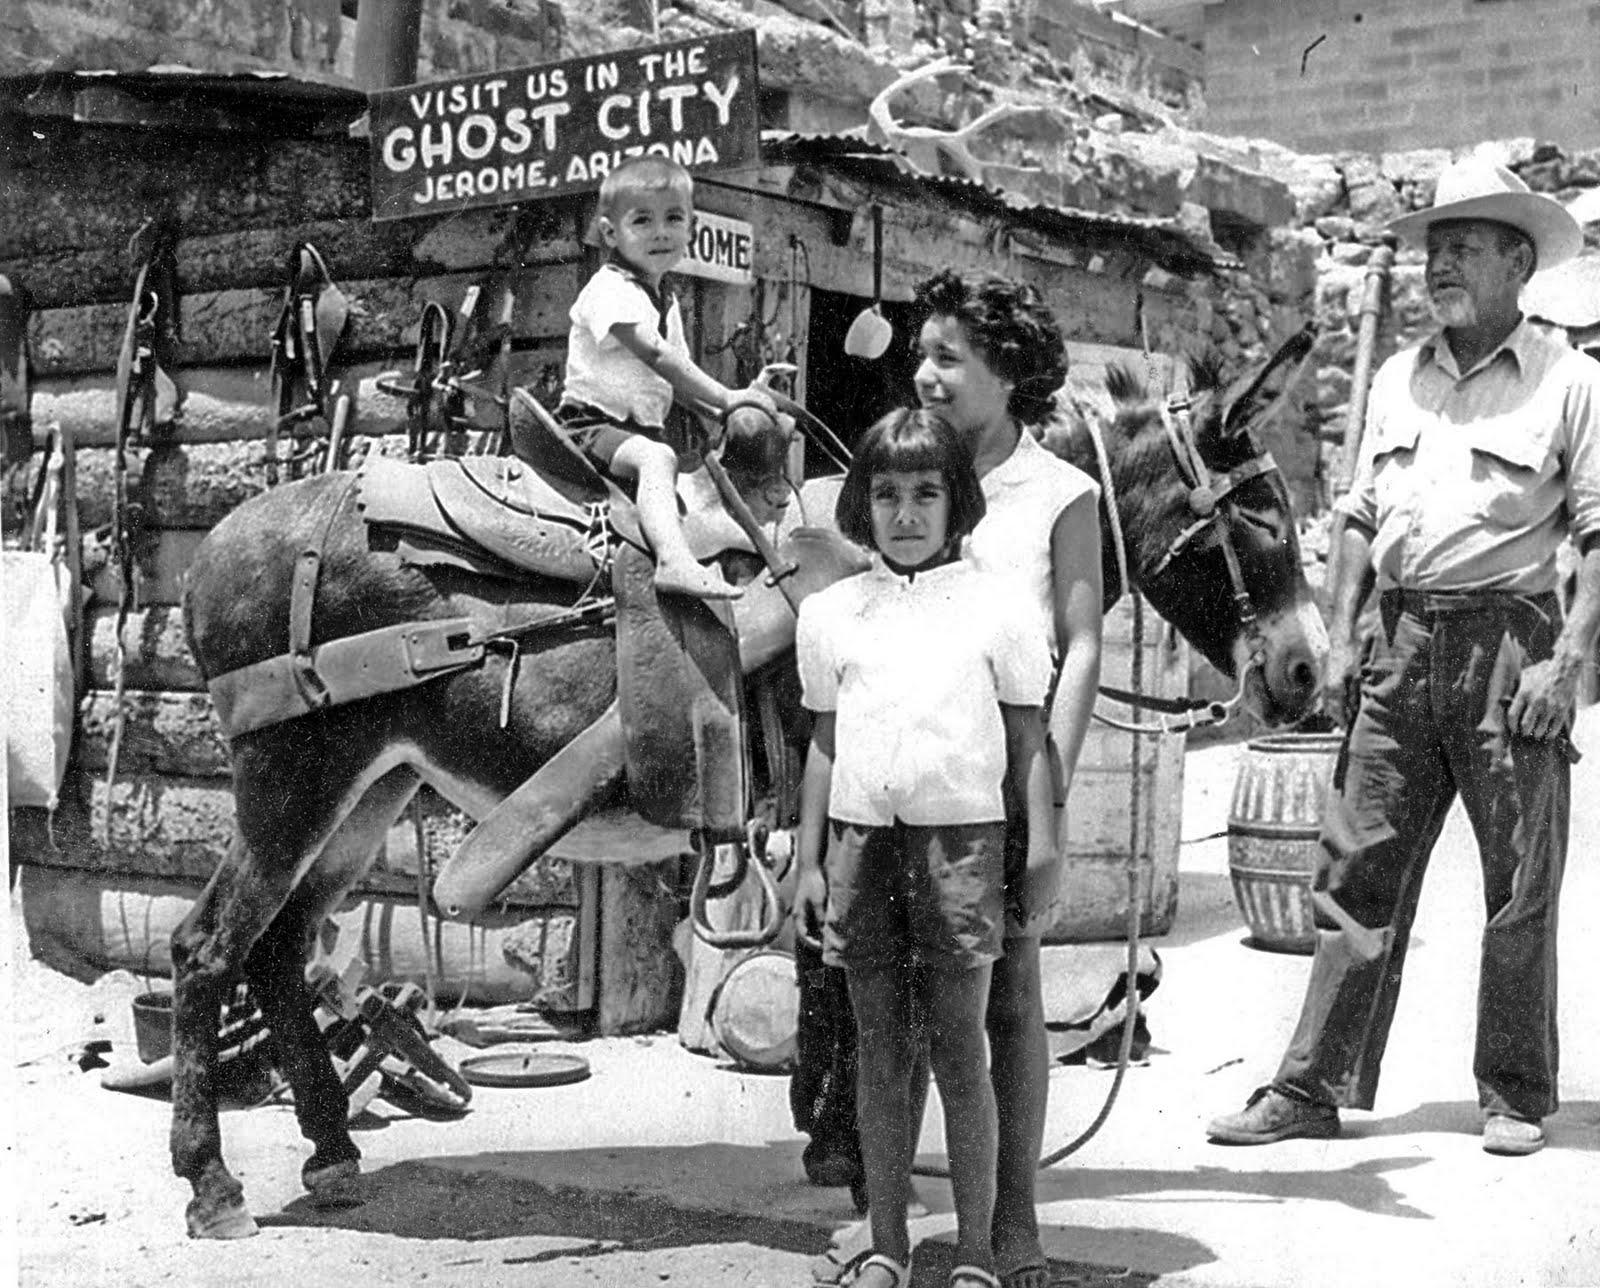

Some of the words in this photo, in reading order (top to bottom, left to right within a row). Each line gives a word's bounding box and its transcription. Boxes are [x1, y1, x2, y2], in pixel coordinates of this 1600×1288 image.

[411, 79, 507, 119] VISIT
[527, 69, 568, 100] US
[586, 61, 618, 92] IN
[639, 47, 708, 82] THE
[383, 101, 571, 172] GHOST
[597, 75, 740, 140] CITY
[413, 159, 558, 202] JEROME,
